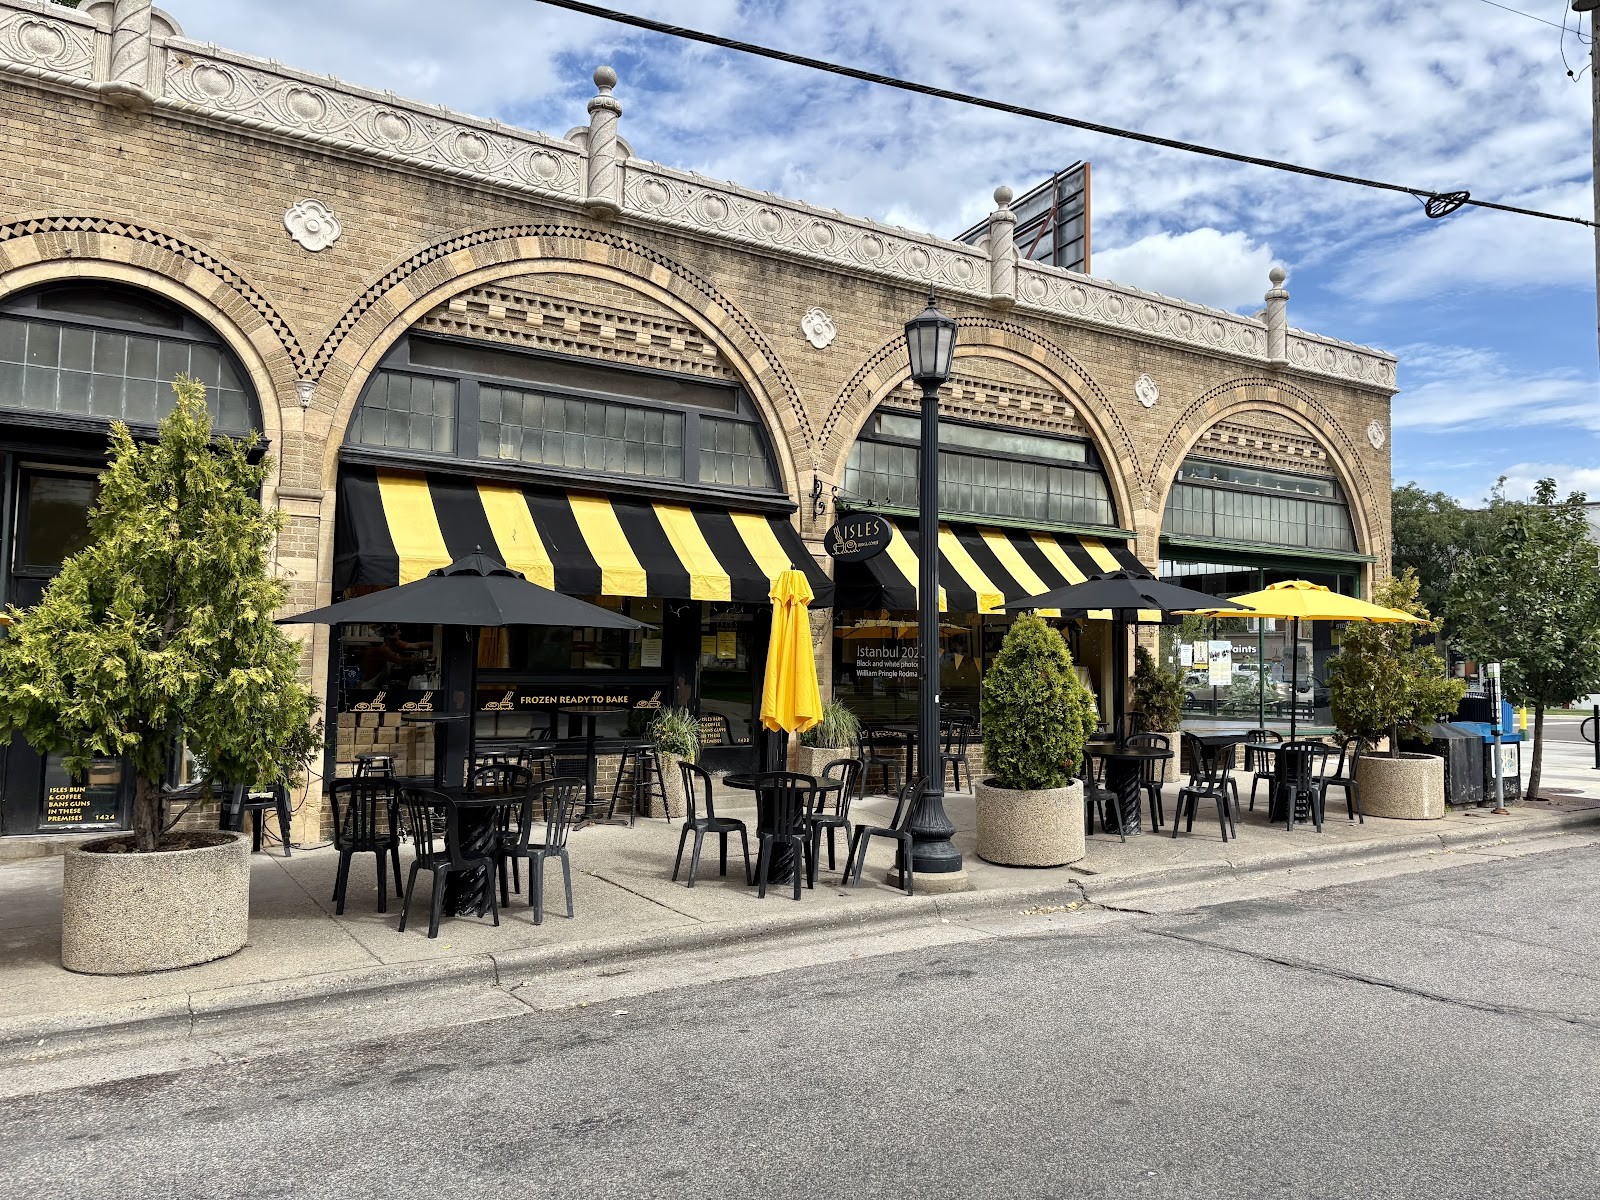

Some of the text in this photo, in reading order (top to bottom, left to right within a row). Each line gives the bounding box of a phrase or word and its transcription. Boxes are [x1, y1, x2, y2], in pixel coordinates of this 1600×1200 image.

[844, 520, 880, 539] ISLES
[856, 644, 919, 659] Istanbul 202
[1231, 644, 1257, 653] aints
[856, 659, 871, 667] Black
[884, 661, 900, 669] white
[900, 660, 919, 670] photo
[856, 669, 918, 679] William Pringle Rodma
[520, 695, 629, 704] FROZEN READY TO BAKE
